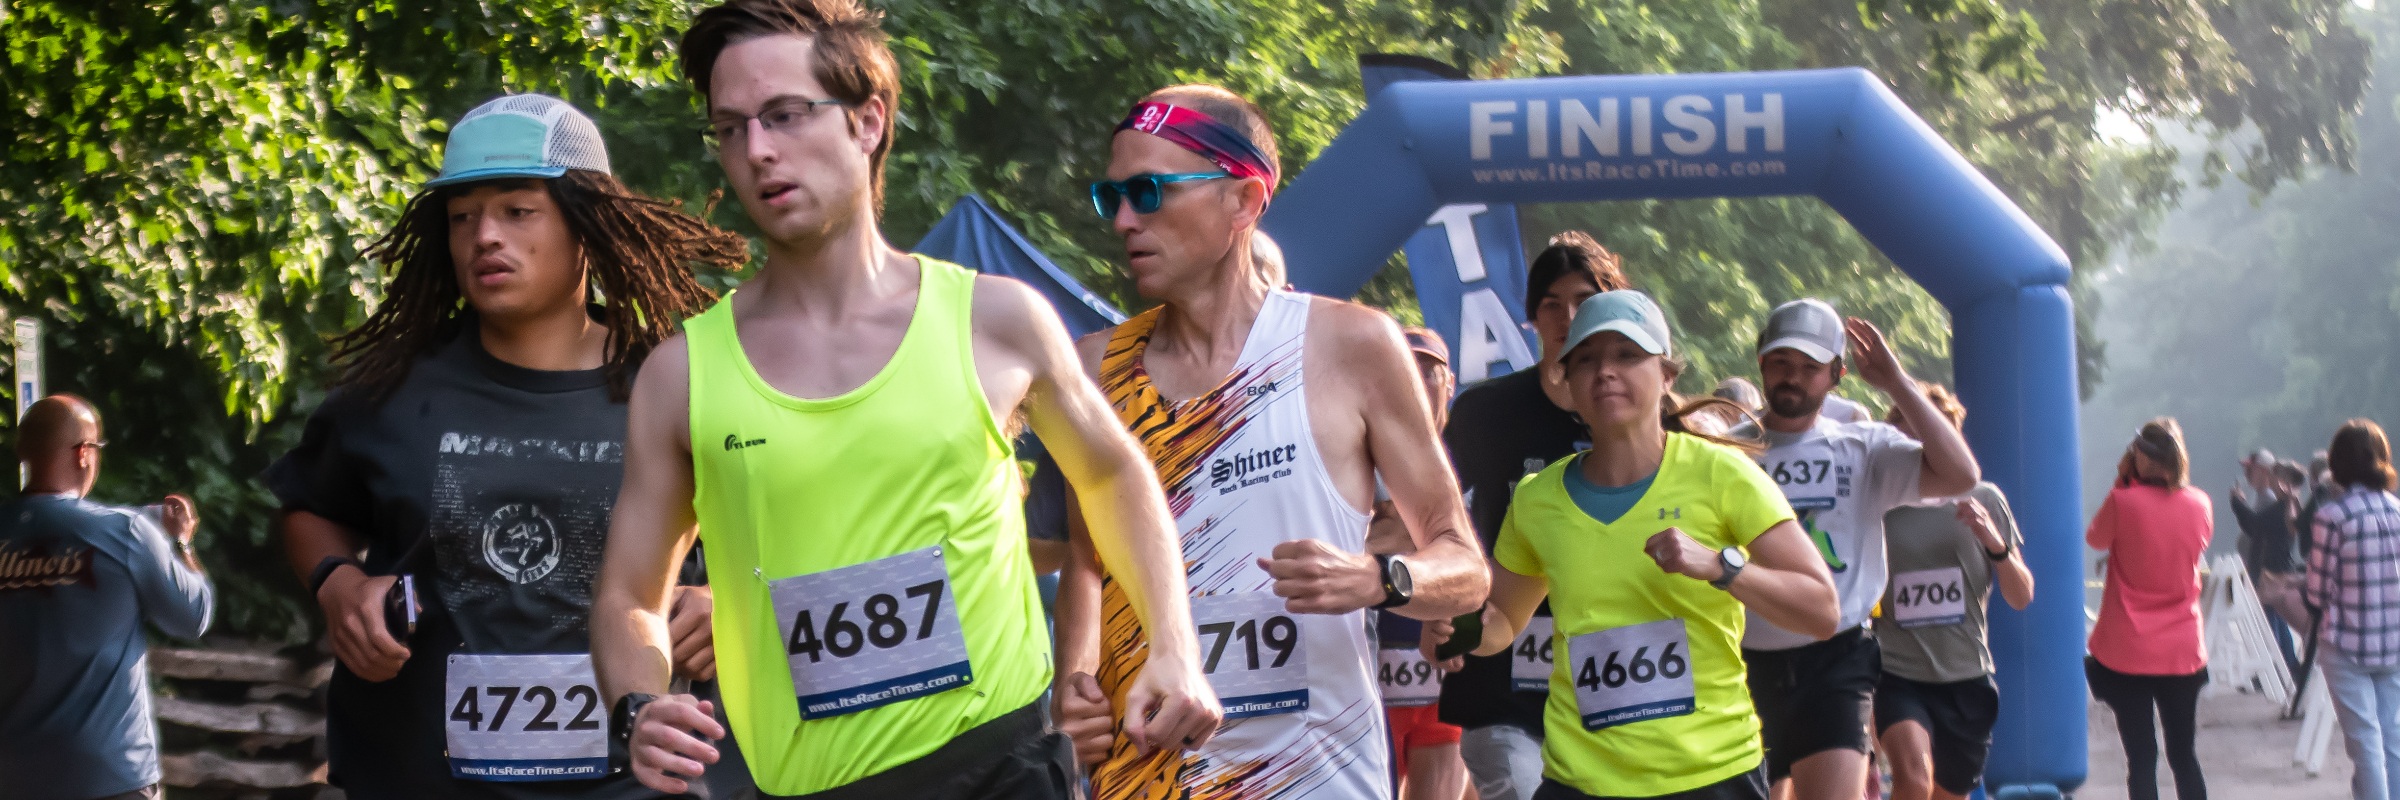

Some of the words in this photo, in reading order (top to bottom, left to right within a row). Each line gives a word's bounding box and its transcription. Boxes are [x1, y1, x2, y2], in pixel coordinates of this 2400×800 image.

[1470, 92, 1785, 161] FINISH
[1471, 159, 1787, 184] www.ItsRaceTime.com
[1247, 382, 1277, 396] BOA
[1211, 443, 1296, 488] Shiner
[1240, 474, 1270, 488] Racing
[1272, 468, 1291, 479] Club
[1760, 460, 1831, 485] 637
[0, 540, 81, 577] llinois
[1896, 581, 1961, 608] 4706
[788, 578, 945, 663] 4687
[1197, 616, 1297, 674] 719
[1515, 633, 1554, 665] 46
[1576, 641, 1686, 692] 4666
[449, 684, 600, 732] 4722
[807, 673, 958, 713] www.ItsRaceTime.com
[1223, 699, 1299, 714] aceTime.com
[461, 765, 594, 777] www.ItsRaceTime.com
